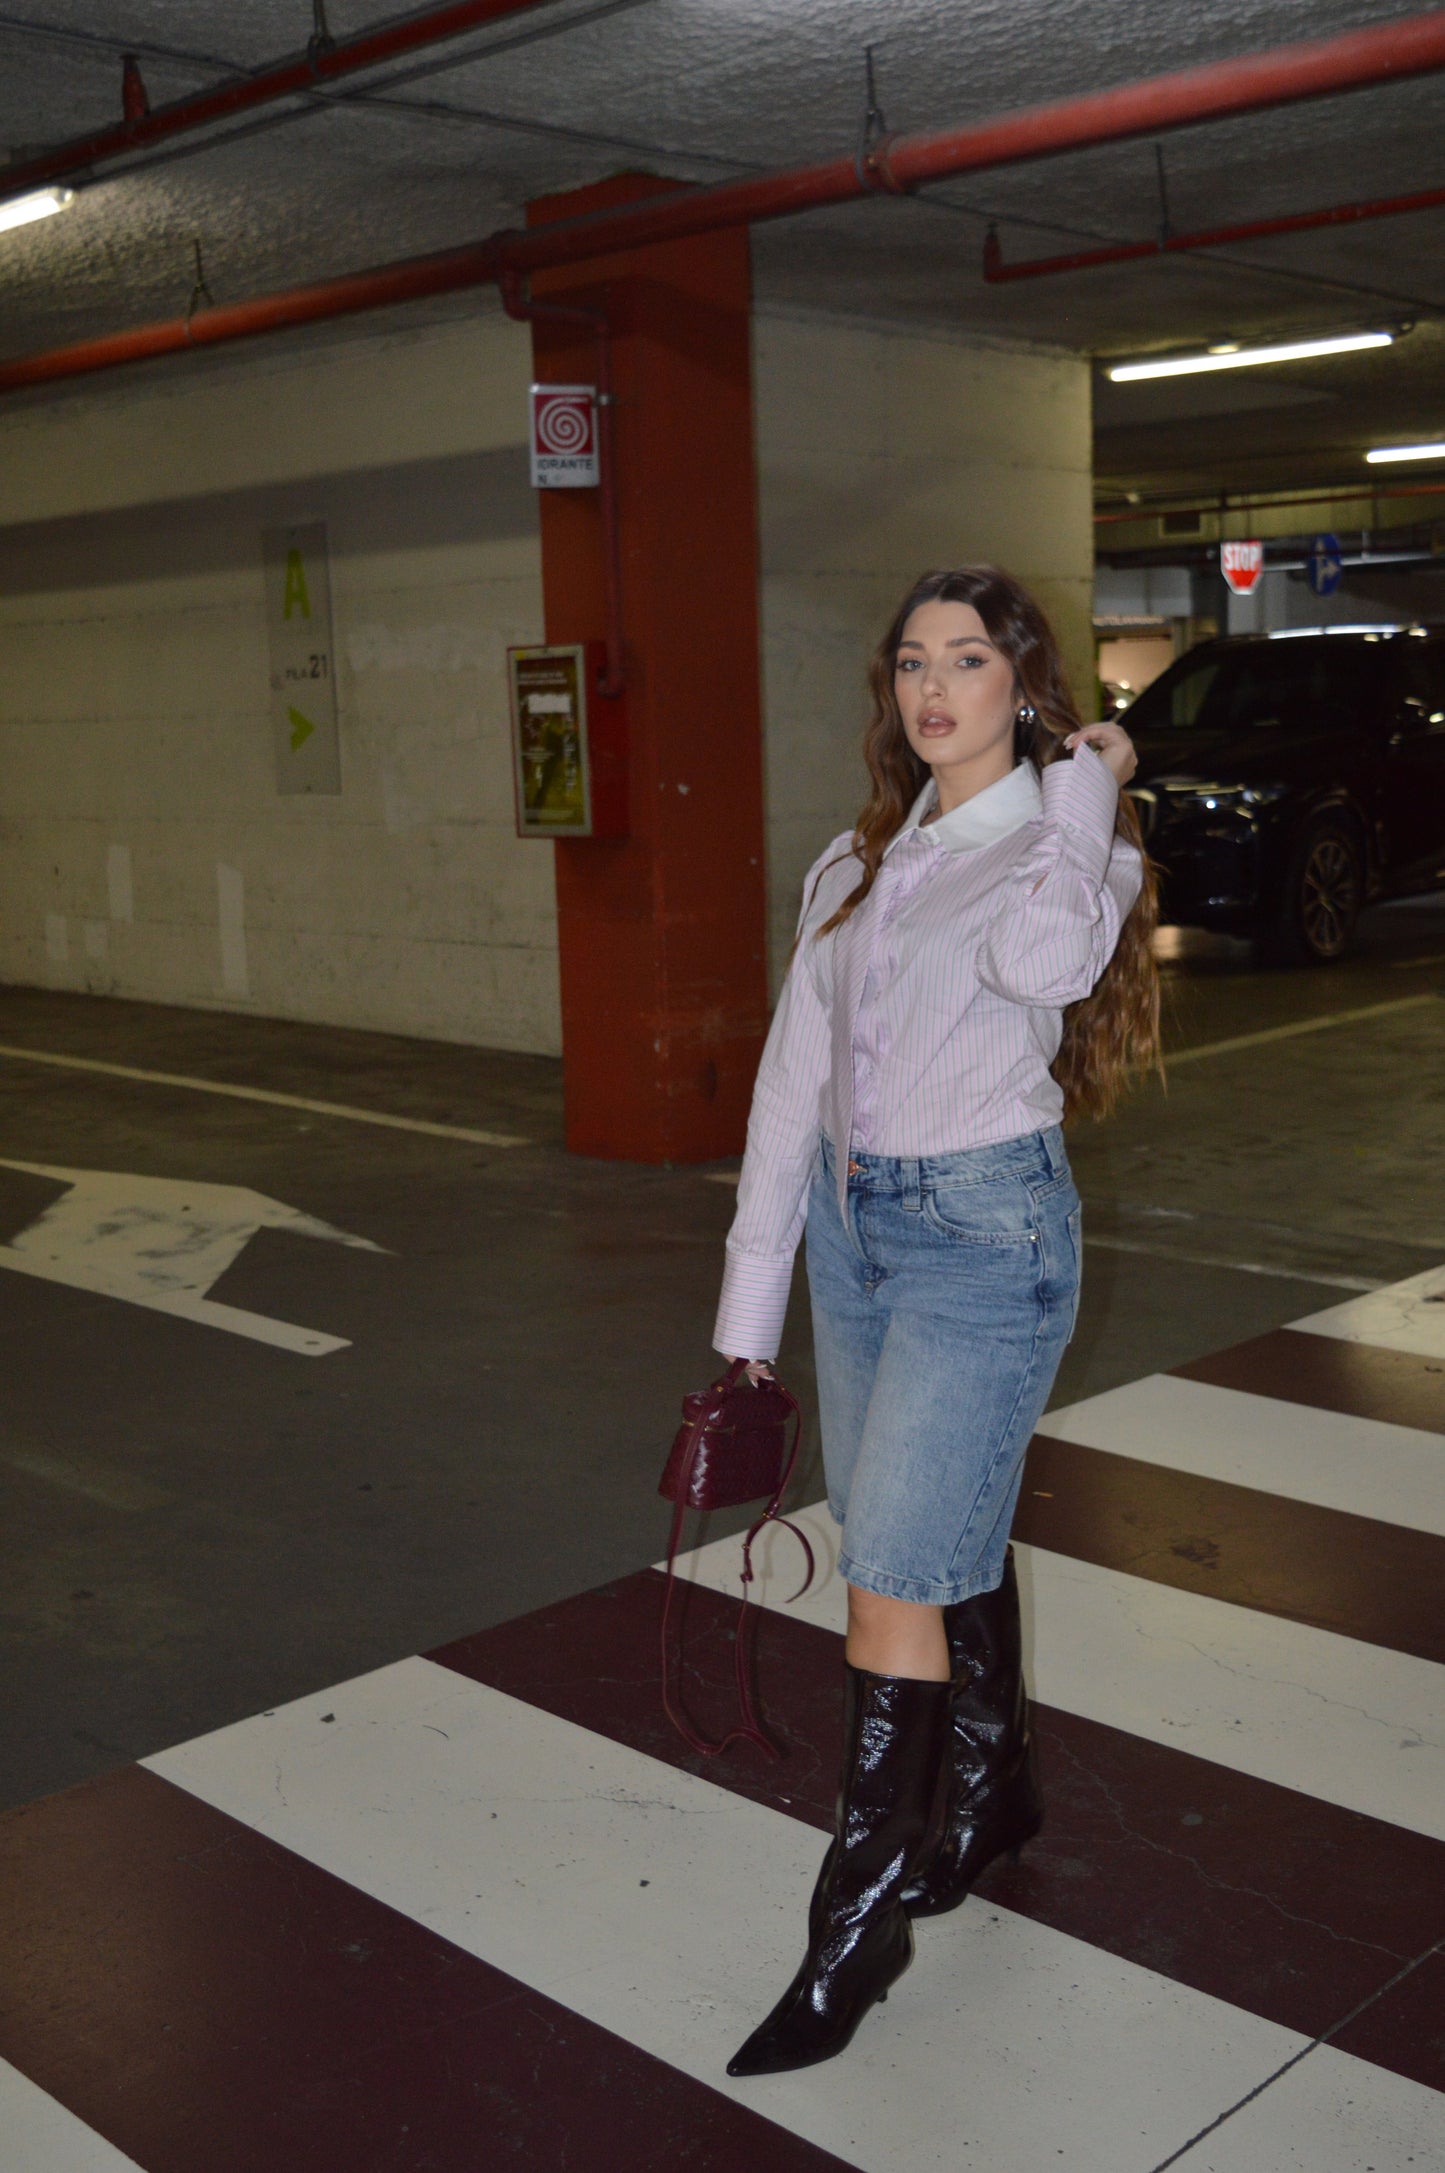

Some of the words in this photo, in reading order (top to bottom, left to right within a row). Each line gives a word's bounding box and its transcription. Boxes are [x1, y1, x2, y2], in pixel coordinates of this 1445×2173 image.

[537, 459, 593, 470] IDRANTE
[1224, 543, 1260, 571] STOP
[284, 549, 311, 620] A
[309, 654, 328, 679] 21
